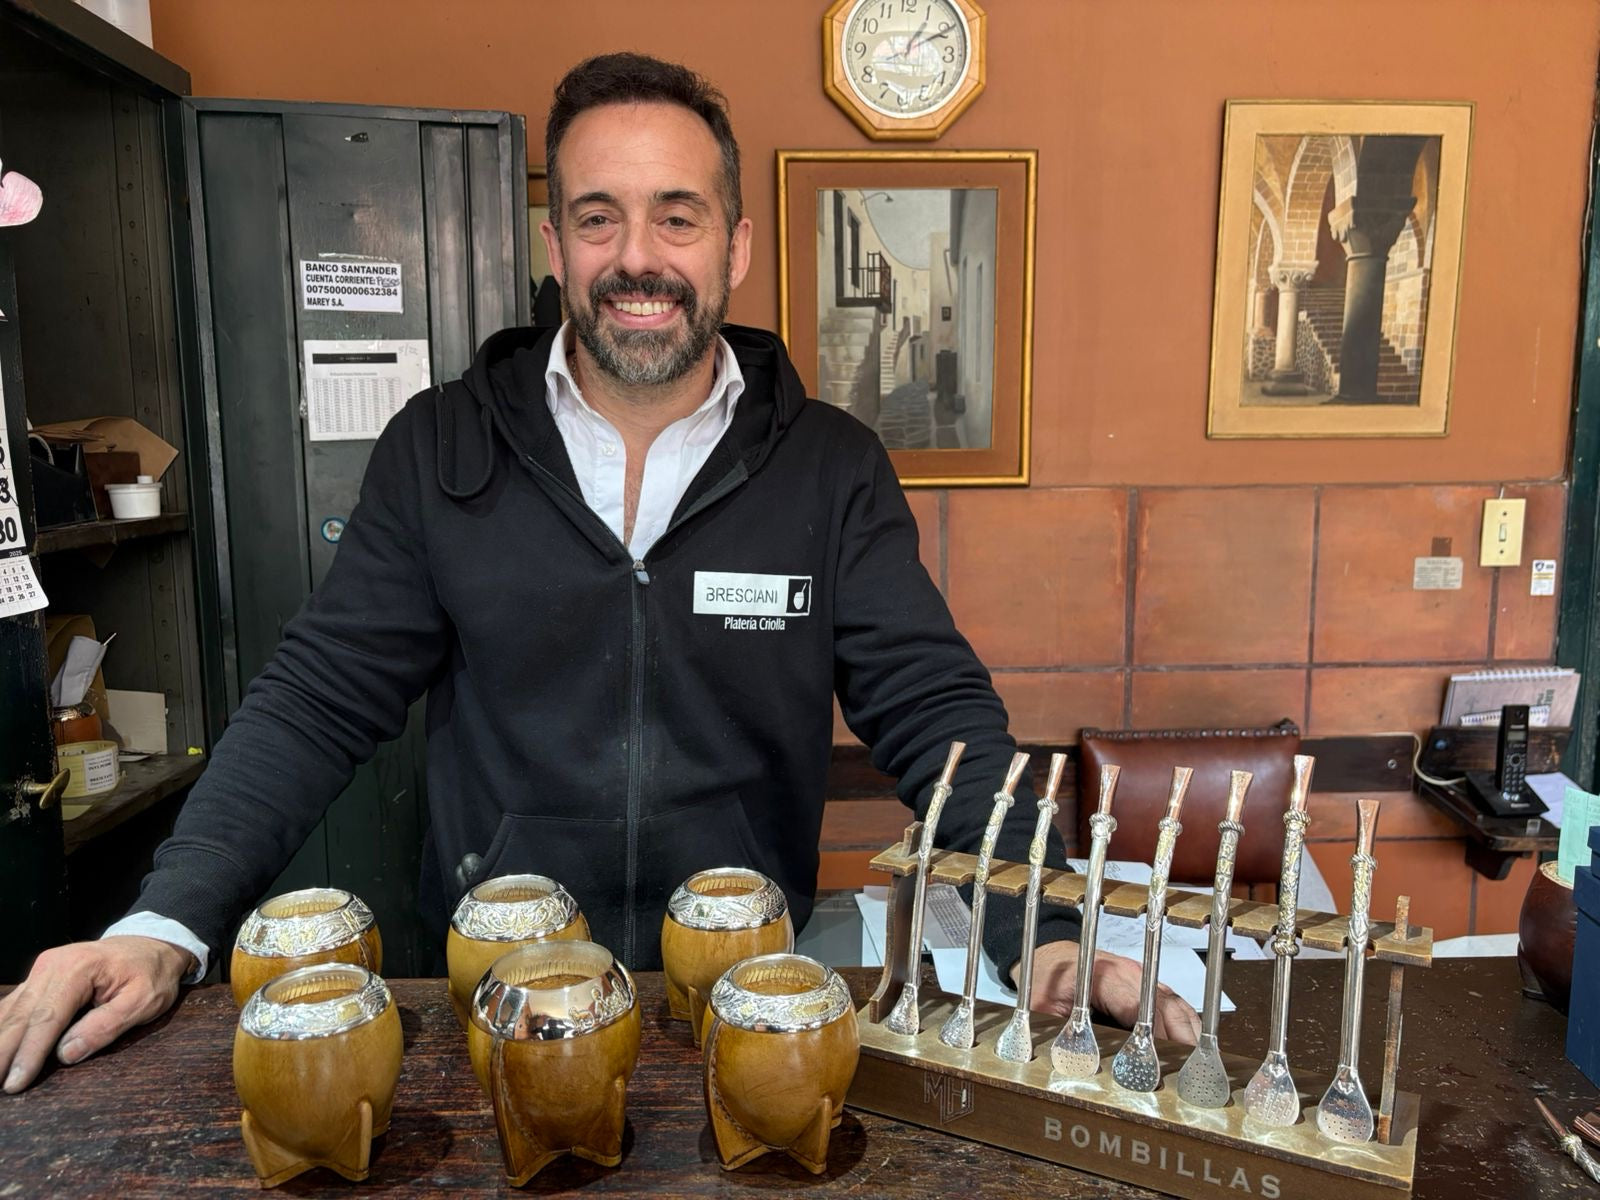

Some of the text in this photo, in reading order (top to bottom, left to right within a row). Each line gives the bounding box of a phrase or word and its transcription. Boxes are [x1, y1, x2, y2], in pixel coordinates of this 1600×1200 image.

[879, 3, 893, 19] 11
[925, 4, 931, 21] 1
[862, 17, 879, 35] 10
[854, 41, 867, 60] 9
[942, 45, 955, 63] 3
[860, 65, 874, 83] 8
[932, 70, 947, 87] 4
[879, 82, 890, 100] 7
[305, 263, 397, 275] BANCO SANTANDER
[306, 274, 376, 285] CUENTA CORRIENTE:
[306, 285, 398, 296] 0075000000632384
[307, 297, 345, 307] MAREY S.A.
[9, 549, 23, 558] 2025
[25, 582, 33, 590] 20
[17, 593, 26, 601] 26
[706, 587, 778, 604] BRESCIANI
[724, 616, 786, 631] Platería Criolla
[1043, 1116, 1282, 1198] BOMBILLAS
